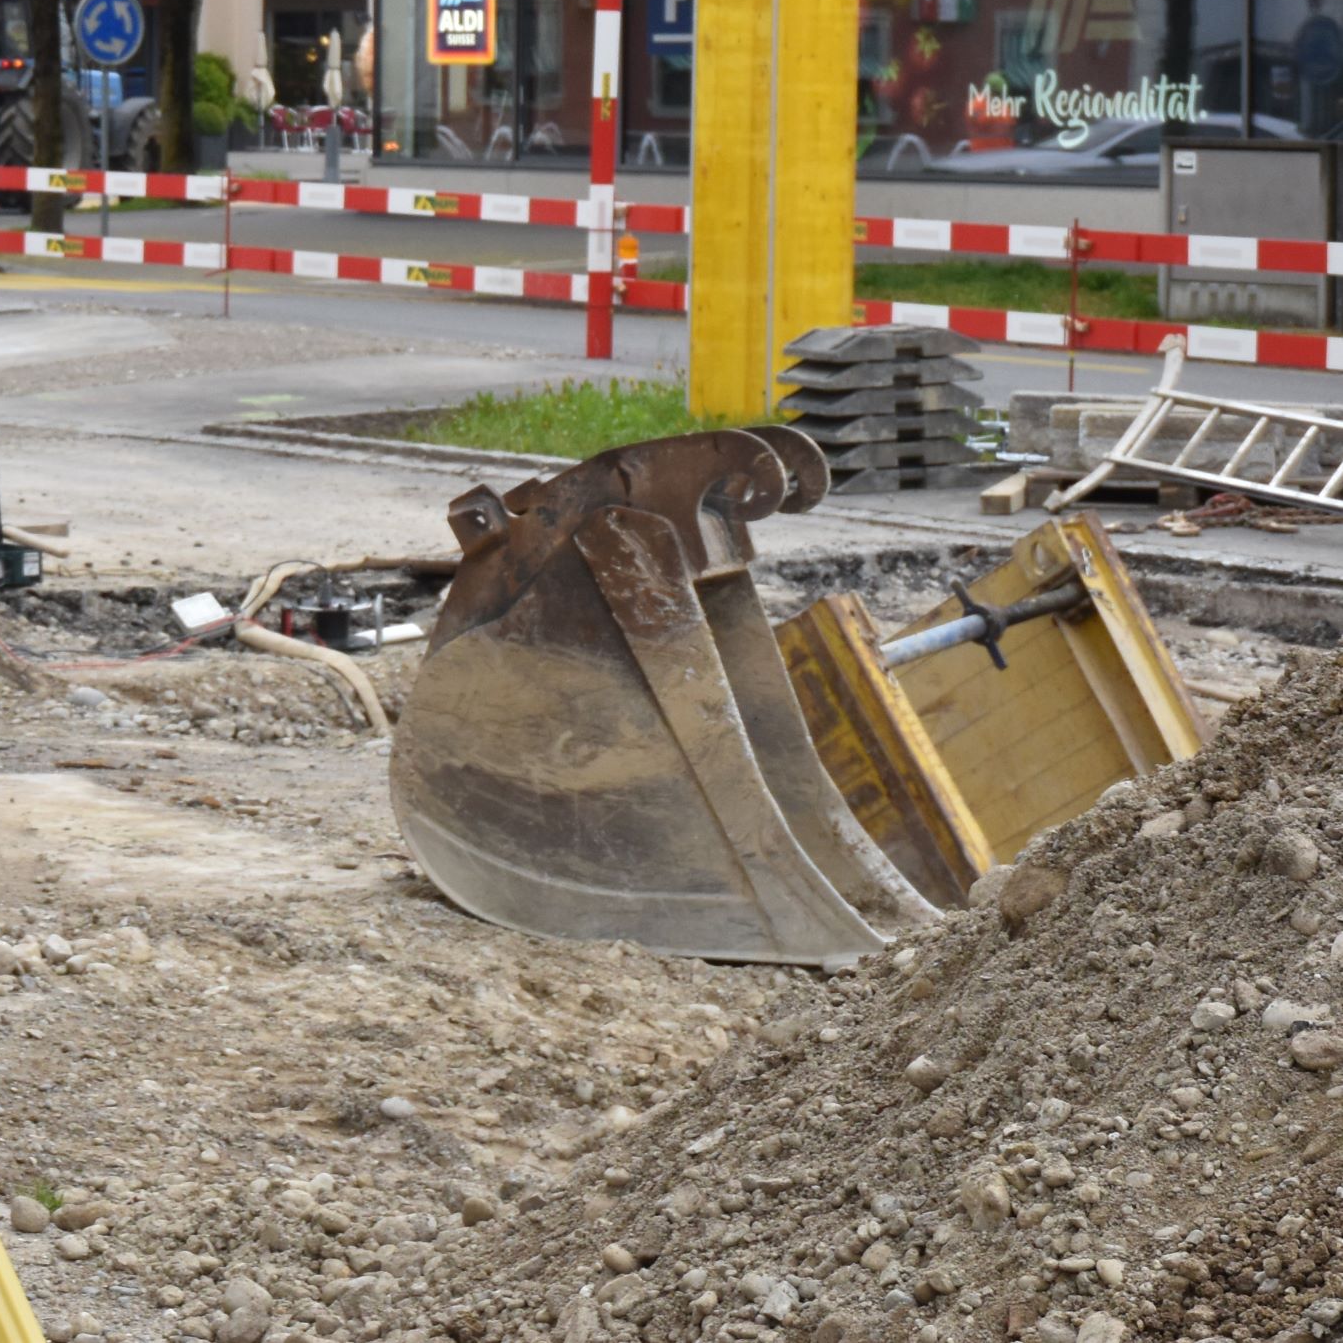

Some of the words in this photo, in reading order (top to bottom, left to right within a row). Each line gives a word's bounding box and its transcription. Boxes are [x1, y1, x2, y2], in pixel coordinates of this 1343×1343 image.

[439, 9, 484, 32] ALDI
[446, 33, 476, 46] SUISSE
[969, 83, 1026, 118] Mehr
